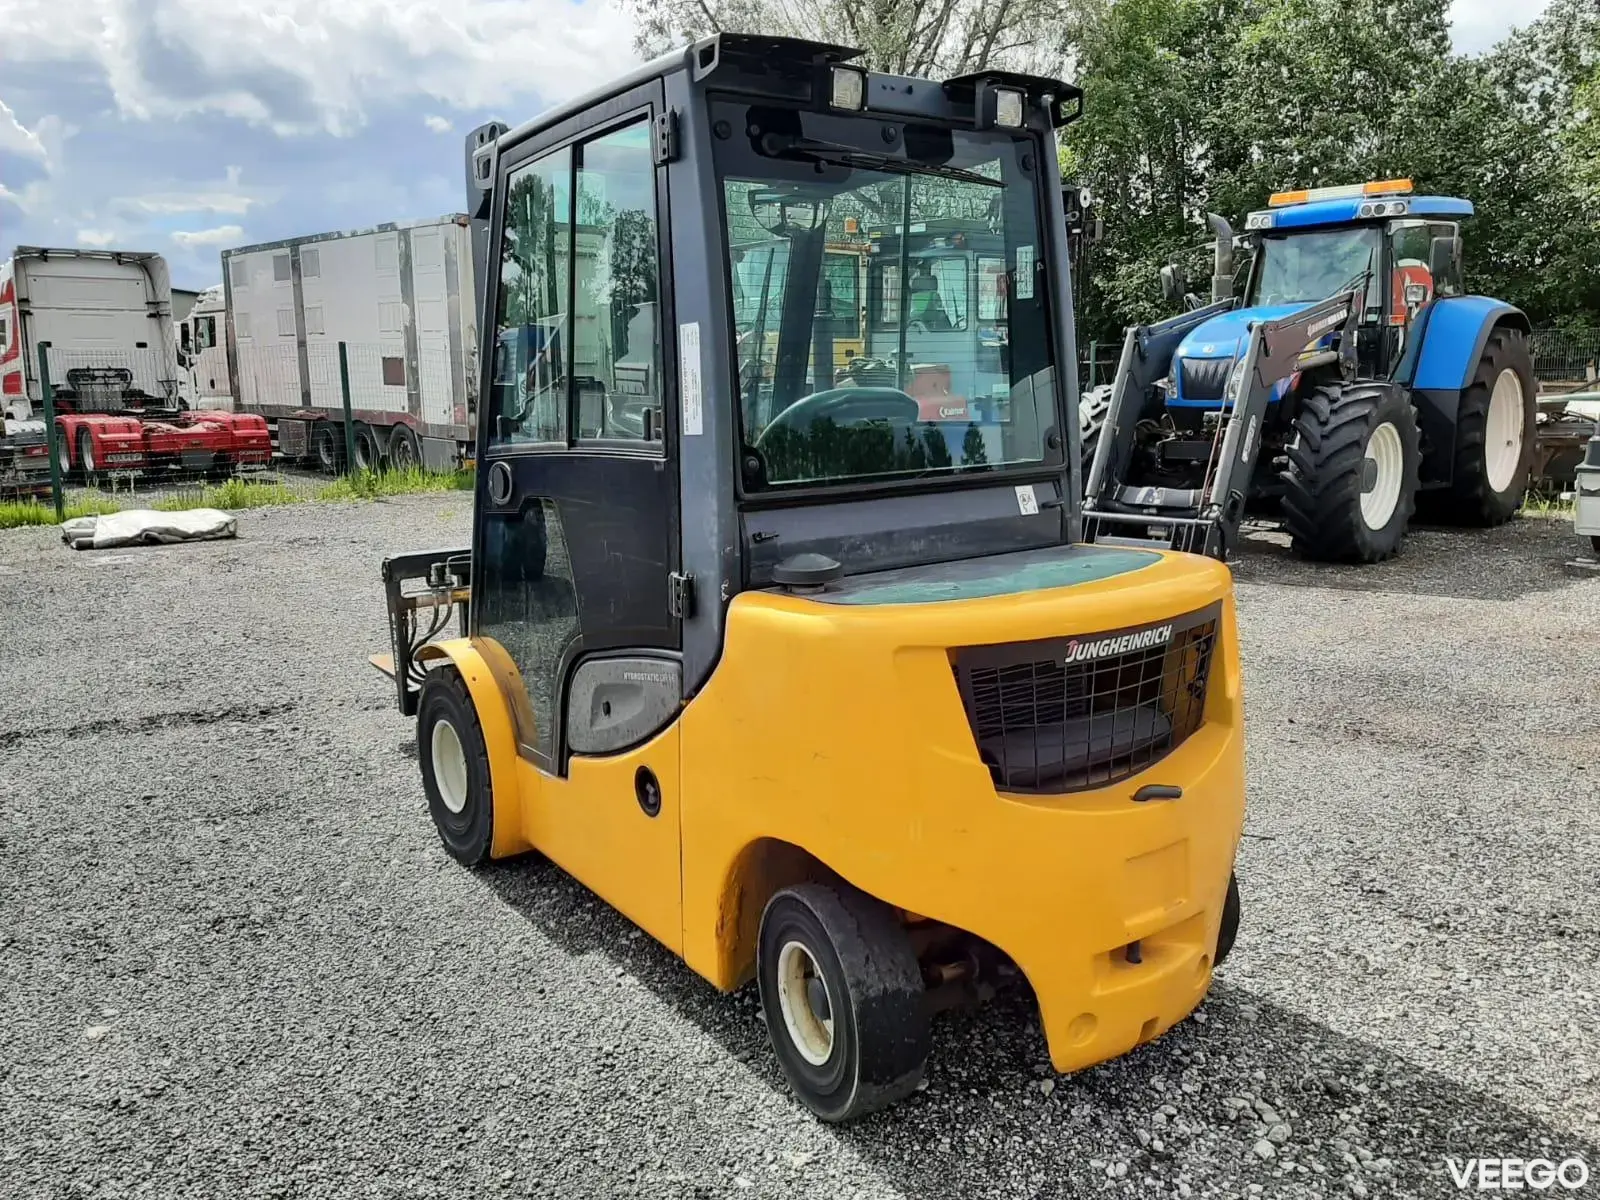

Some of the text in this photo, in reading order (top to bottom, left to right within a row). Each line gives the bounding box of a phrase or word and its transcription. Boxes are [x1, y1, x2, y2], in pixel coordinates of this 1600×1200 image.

[107, 469, 144, 478] SCANIA
[1065, 624, 1173, 663] JUNGHEINRICH
[623, 672, 660, 682] HYDROSTATIC
